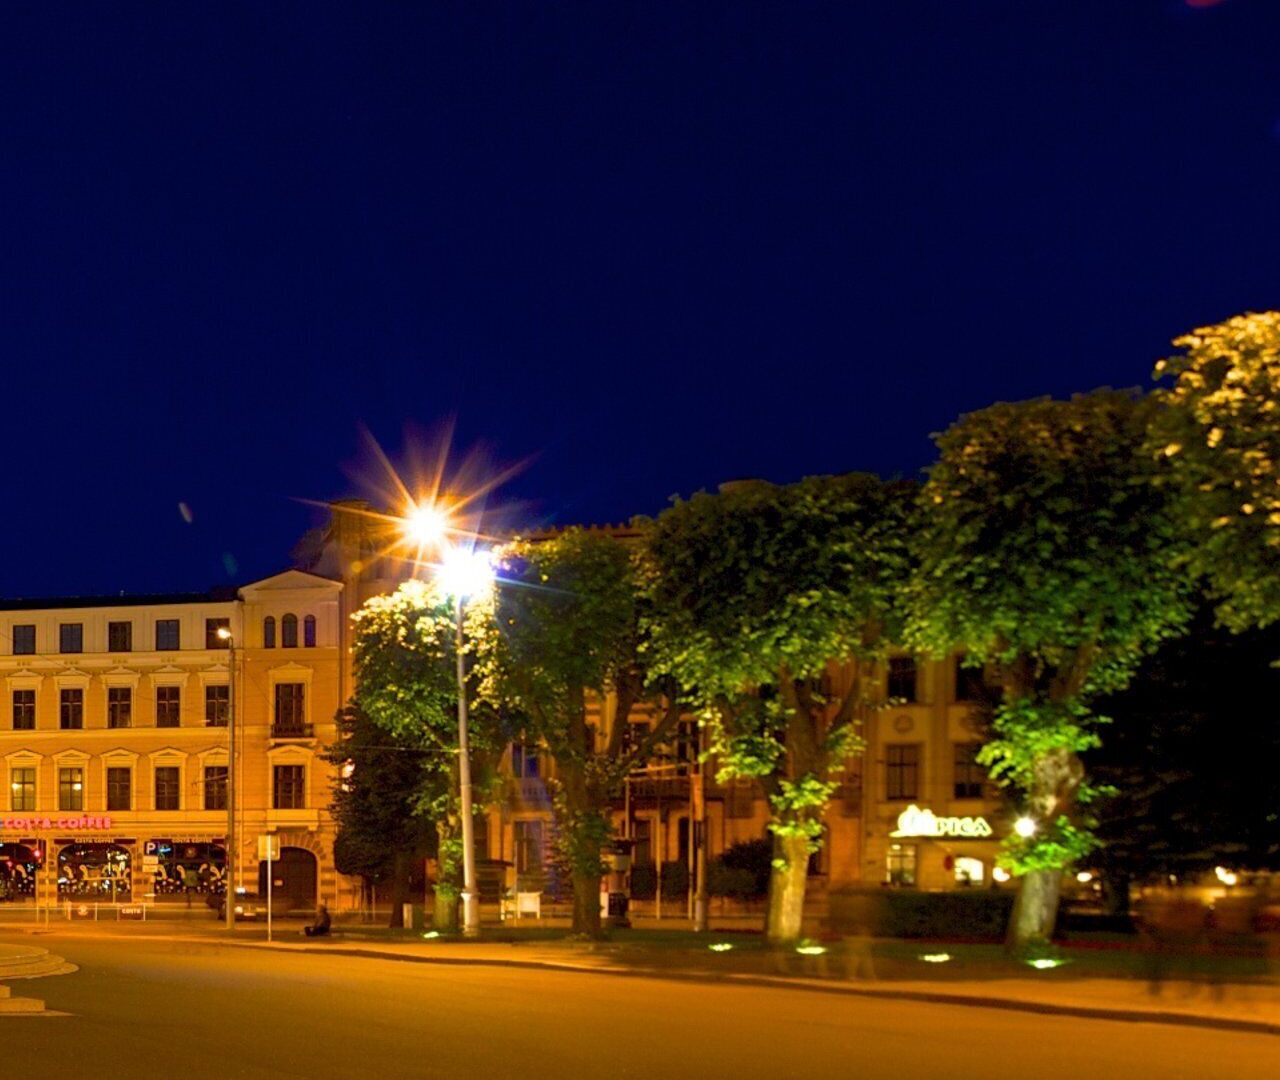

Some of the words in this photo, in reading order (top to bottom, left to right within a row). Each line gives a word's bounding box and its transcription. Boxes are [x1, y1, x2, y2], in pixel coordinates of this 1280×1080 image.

[3, 816, 52, 831] COSTA
[57, 815, 111, 830] COFFEE
[145, 841, 157, 855] P
